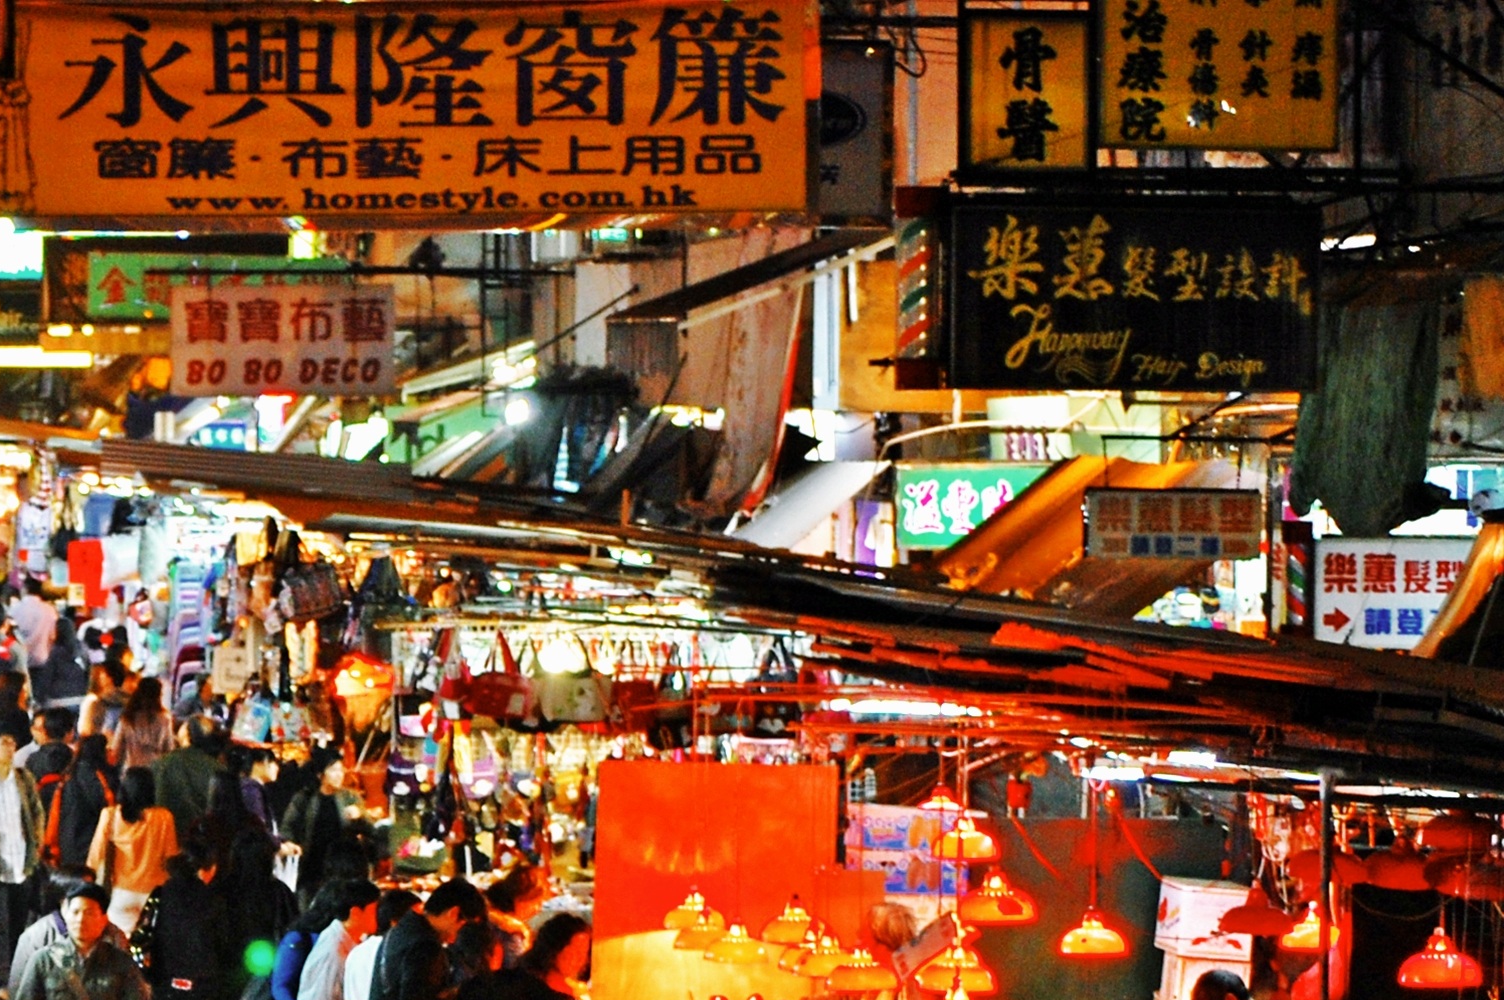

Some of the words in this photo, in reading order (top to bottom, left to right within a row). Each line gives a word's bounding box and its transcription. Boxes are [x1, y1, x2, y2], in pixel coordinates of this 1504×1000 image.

[57, 7, 787, 127] 永興隆窗簾
[997, 26, 1059, 162] 骨醫
[243, 358, 283, 385] BO
[298, 357, 382, 385] DECO
[1364, 607, 1440, 635] 請登
